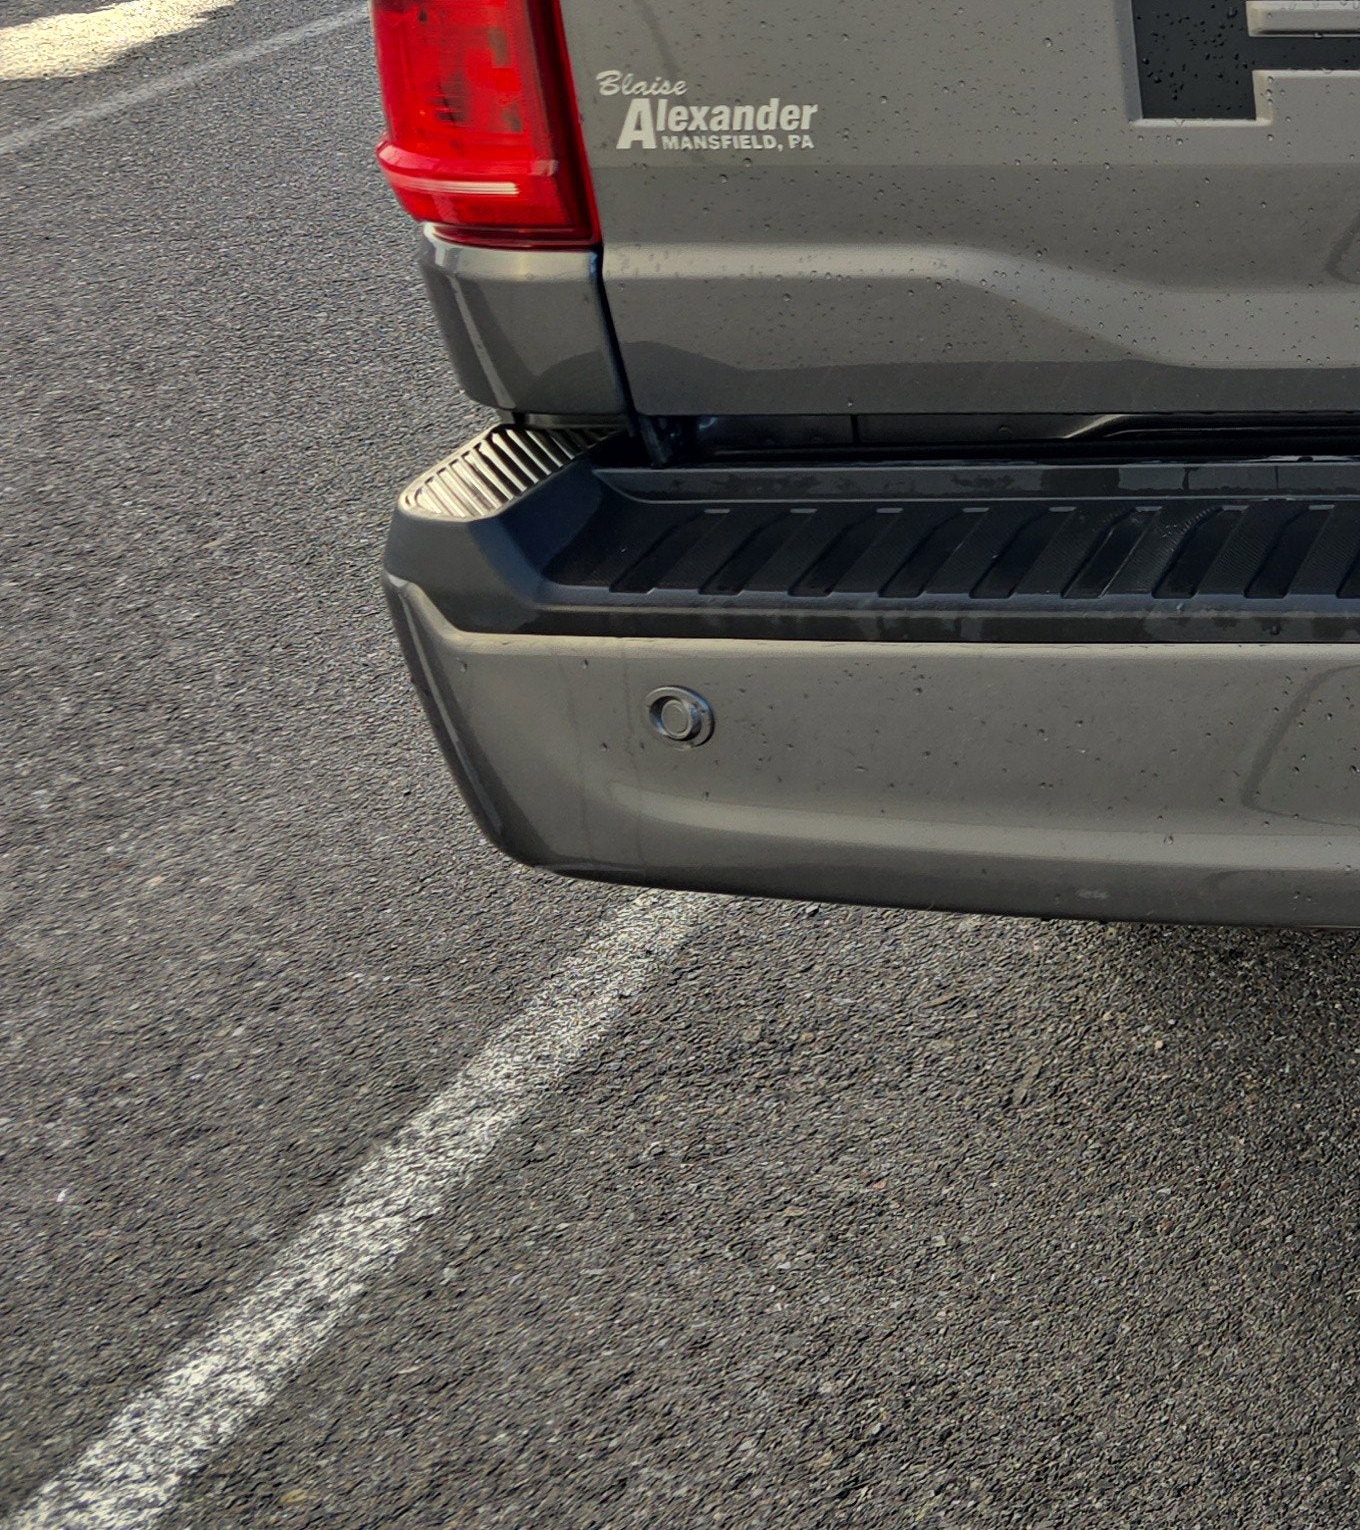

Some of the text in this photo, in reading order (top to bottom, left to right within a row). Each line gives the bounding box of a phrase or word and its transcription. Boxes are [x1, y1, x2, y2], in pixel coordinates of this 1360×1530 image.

[596, 70, 689, 96] Blaise
[616, 98, 818, 149] Alexander
[662, 134, 814, 151] MANSFIELD, PA
